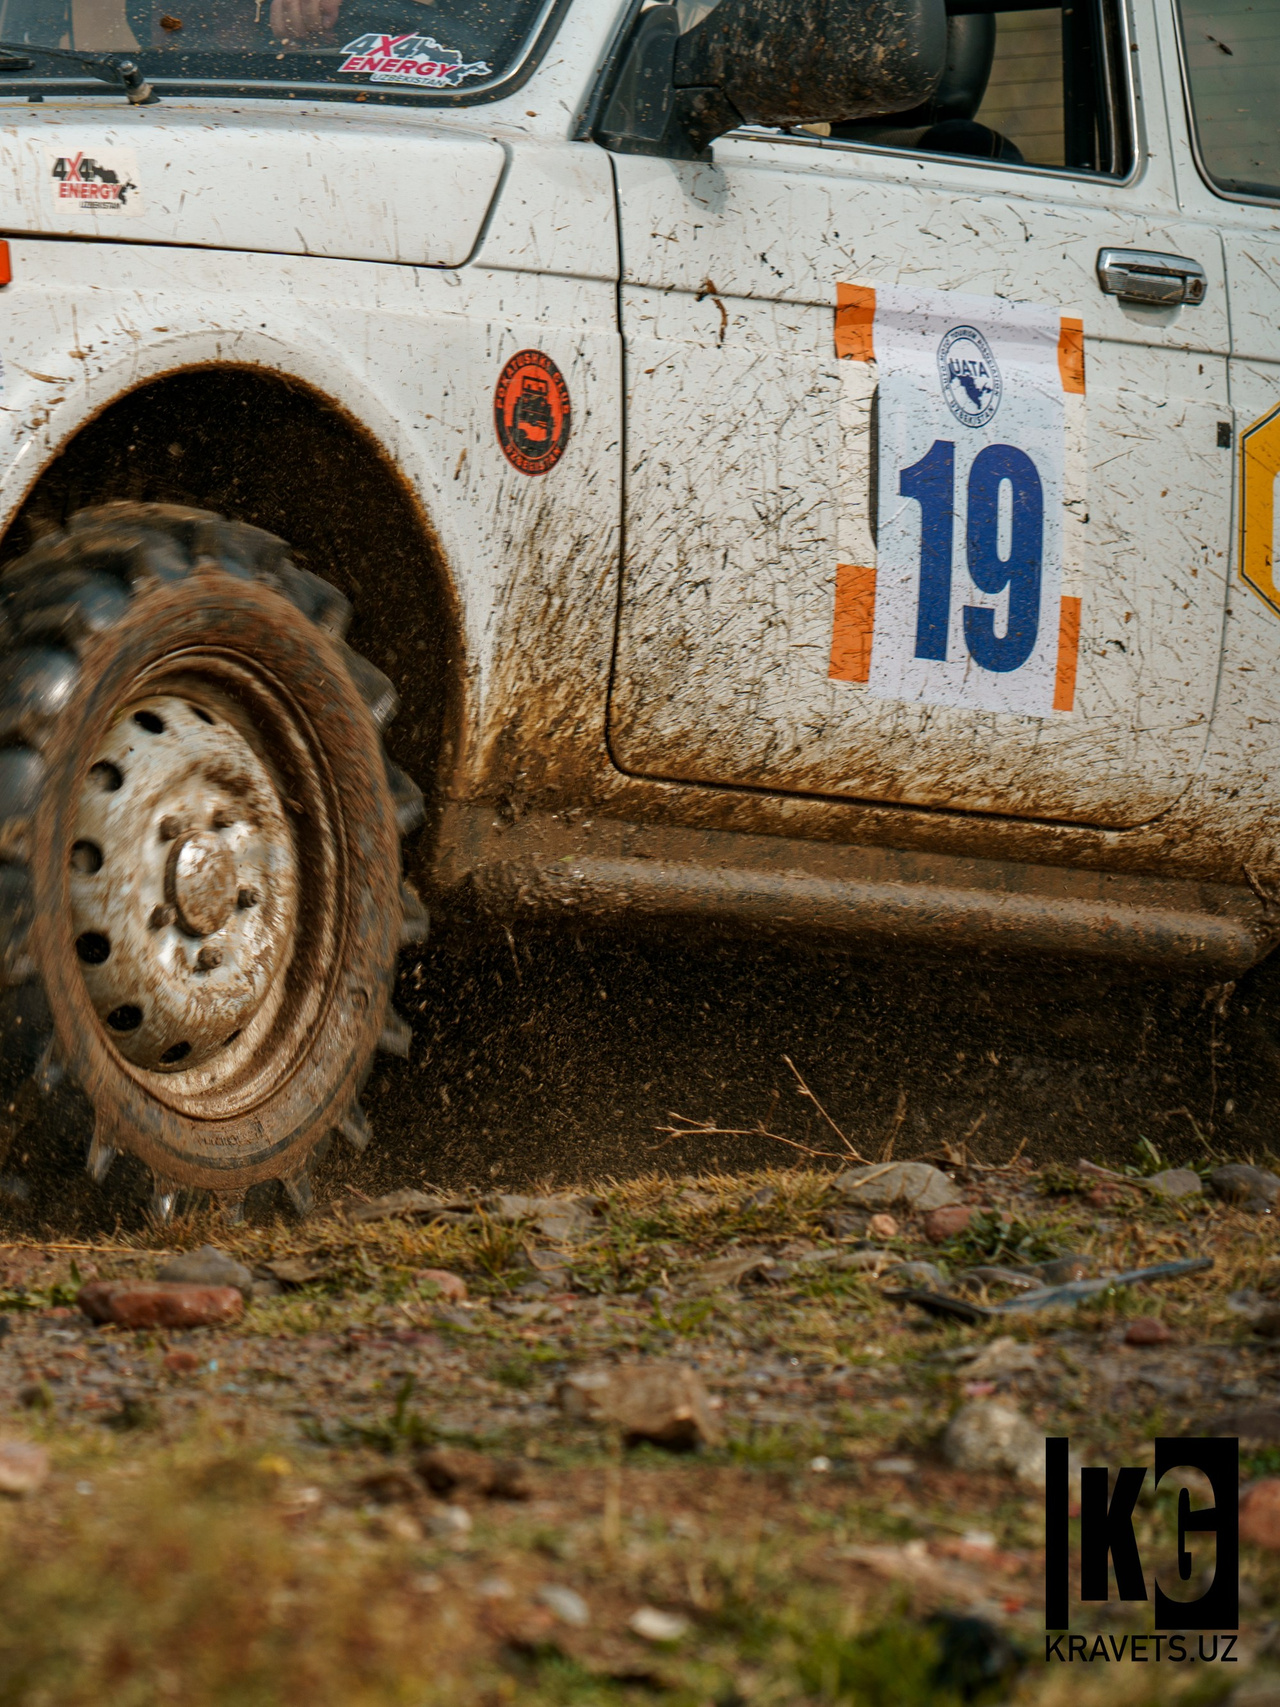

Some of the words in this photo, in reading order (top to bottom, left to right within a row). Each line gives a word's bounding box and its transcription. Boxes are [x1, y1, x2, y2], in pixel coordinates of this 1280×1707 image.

[346, 32, 421, 57] 4X4
[342, 57, 459, 78] ENERGY
[373, 73, 447, 87] UZBEKISTAN
[52, 151, 95, 181] 4X4
[59, 182, 122, 200] ENERGY
[950, 329, 978, 340] TOURISM
[949, 357, 991, 379] UATA
[495, 352, 551, 409] POKATUSHKI
[553, 371, 571, 414] CLUB
[899, 439, 1044, 673] 19
